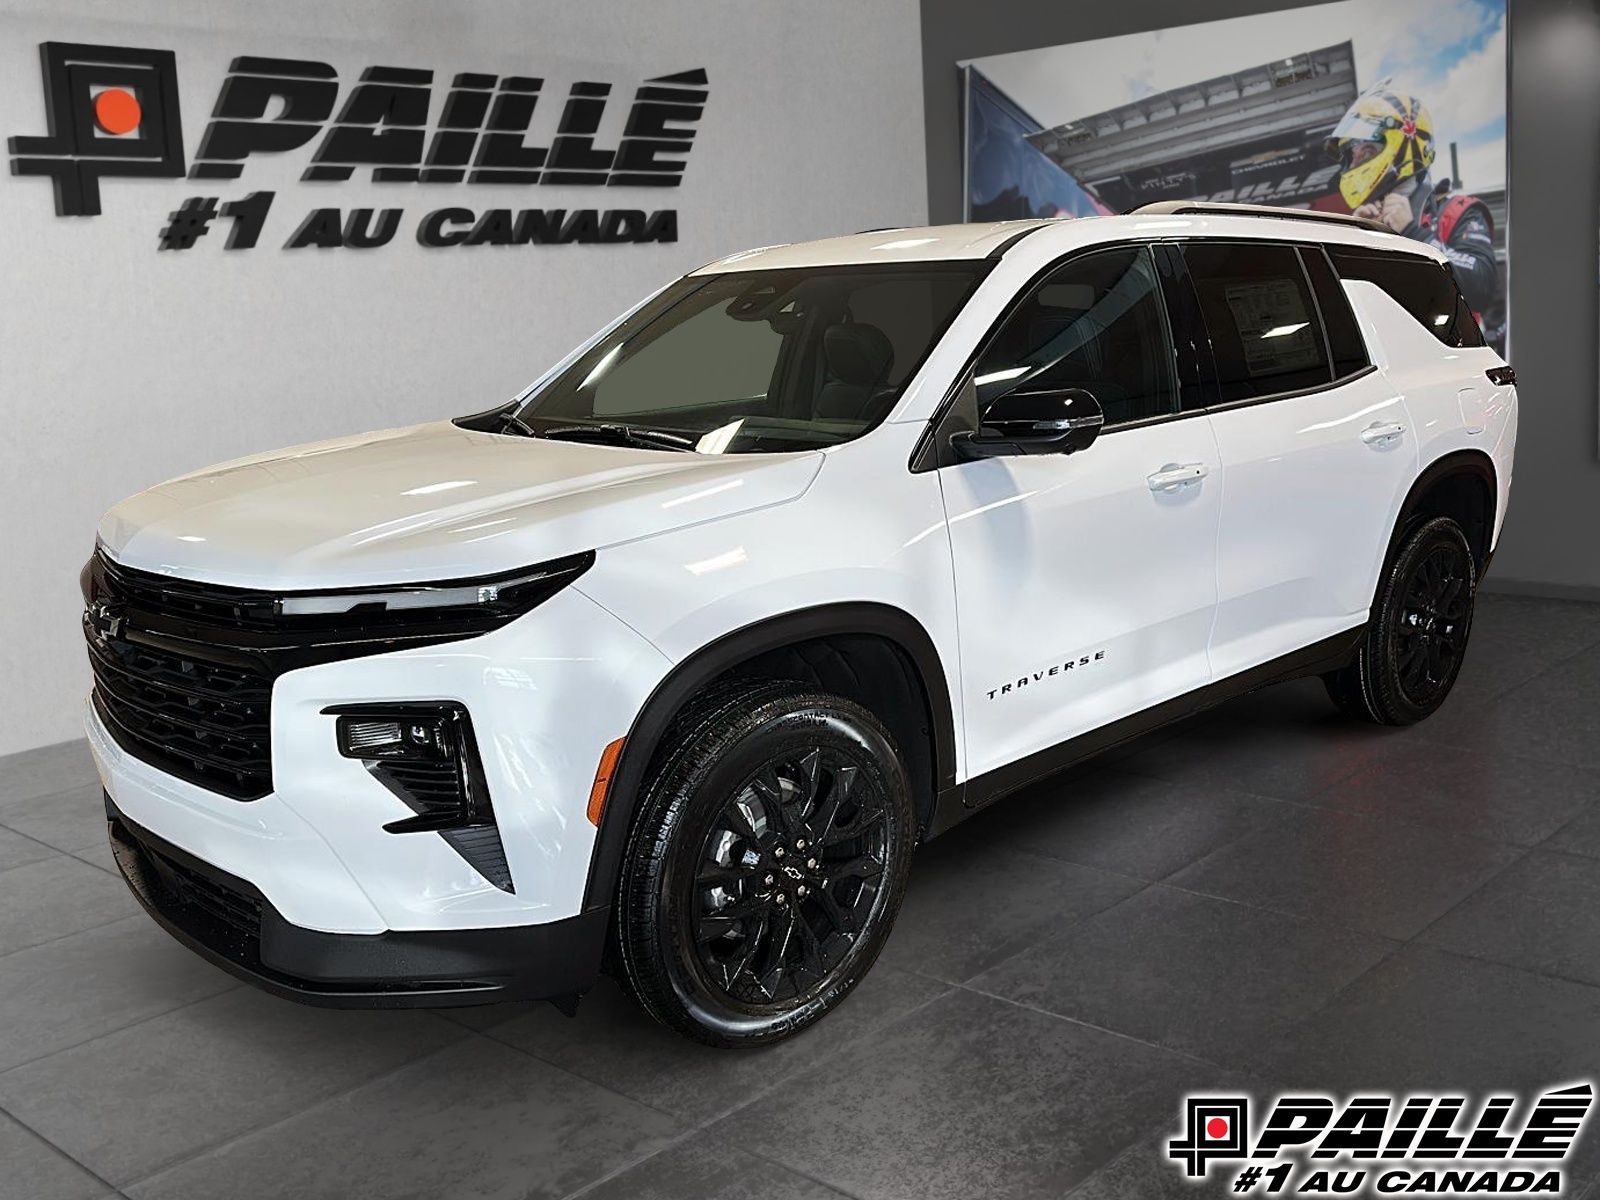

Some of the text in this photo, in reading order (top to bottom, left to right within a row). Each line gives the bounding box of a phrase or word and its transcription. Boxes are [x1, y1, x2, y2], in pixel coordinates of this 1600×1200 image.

[187, 56, 709, 187] PAILLÉ
[158, 190, 679, 252] #1 AU CANADA
[986, 650, 1106, 700] TRAVERSE
